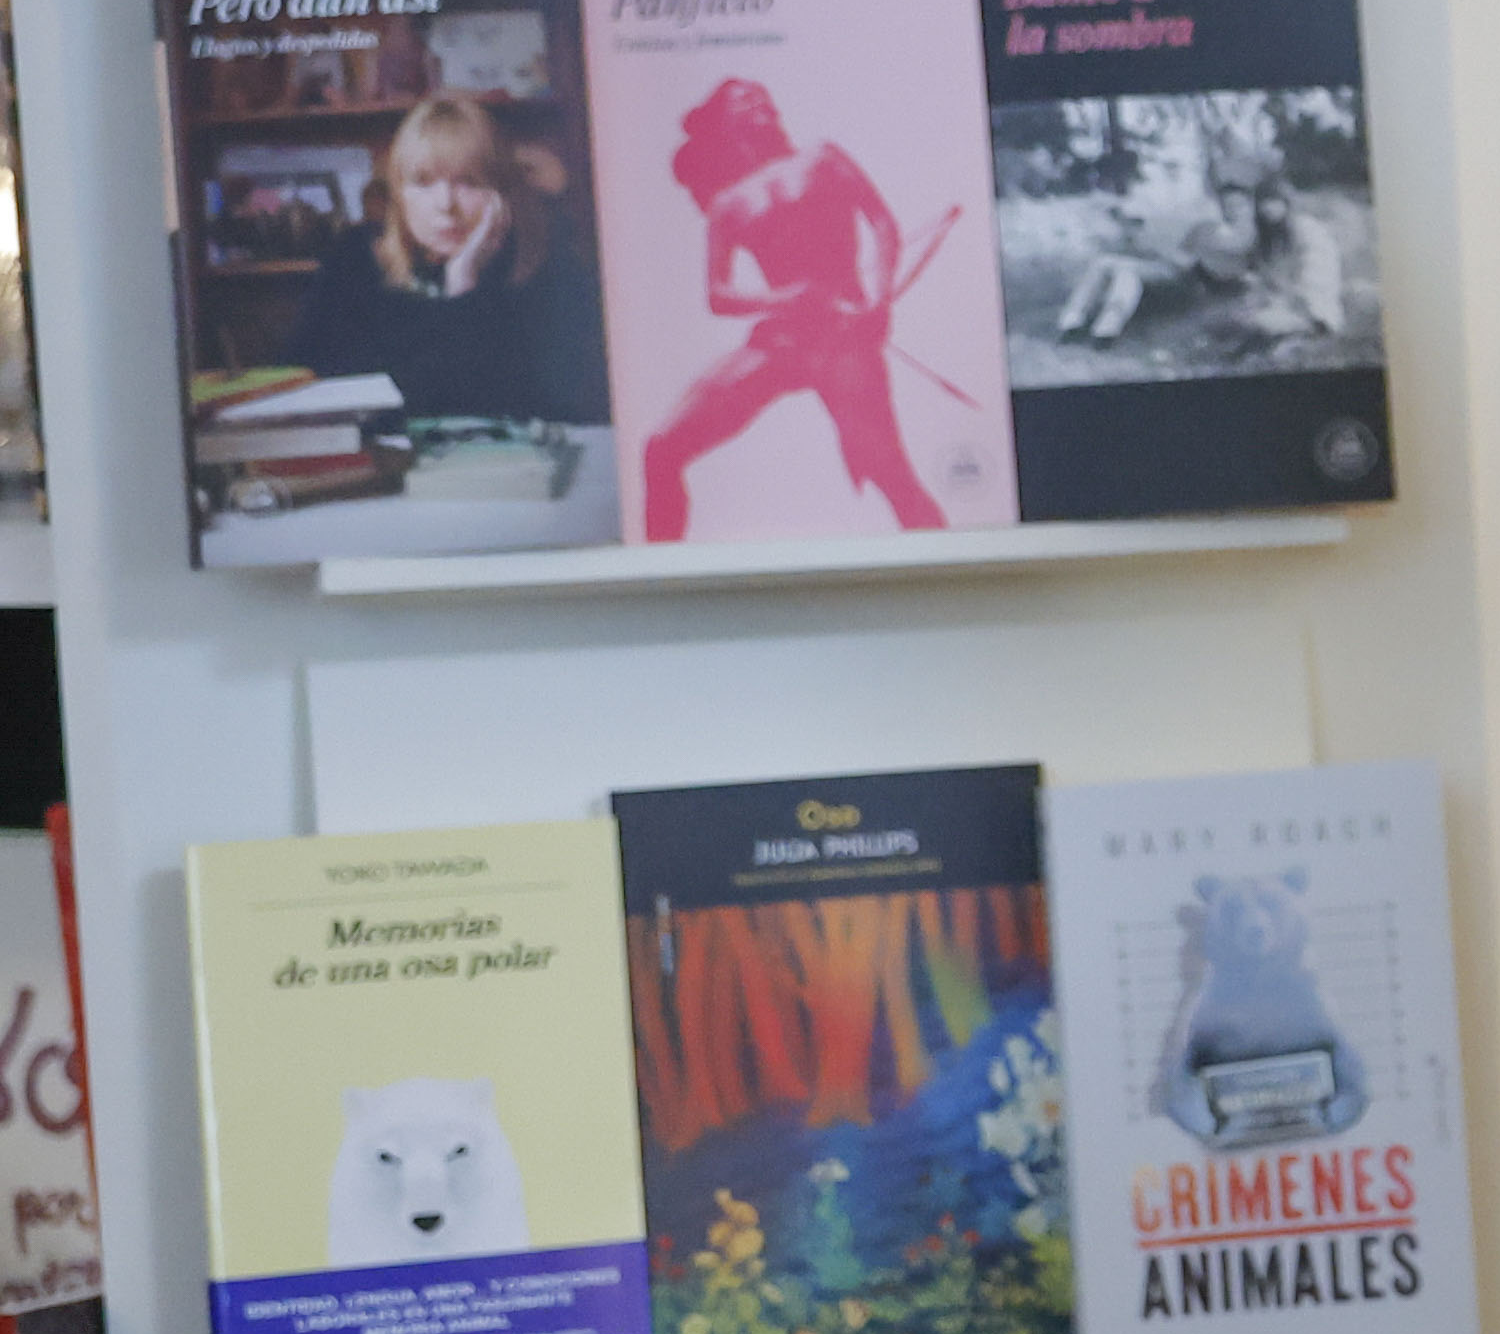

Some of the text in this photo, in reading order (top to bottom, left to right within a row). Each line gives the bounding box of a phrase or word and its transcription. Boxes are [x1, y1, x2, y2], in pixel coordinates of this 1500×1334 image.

[1005, 7, 1194, 56] la sombra
[753, 836, 820, 866] JULIA
[327, 908, 503, 949] Memorias
[273, 941, 557, 989] de una osa polar
[1142, 1232, 1423, 1321] ANIMALES
